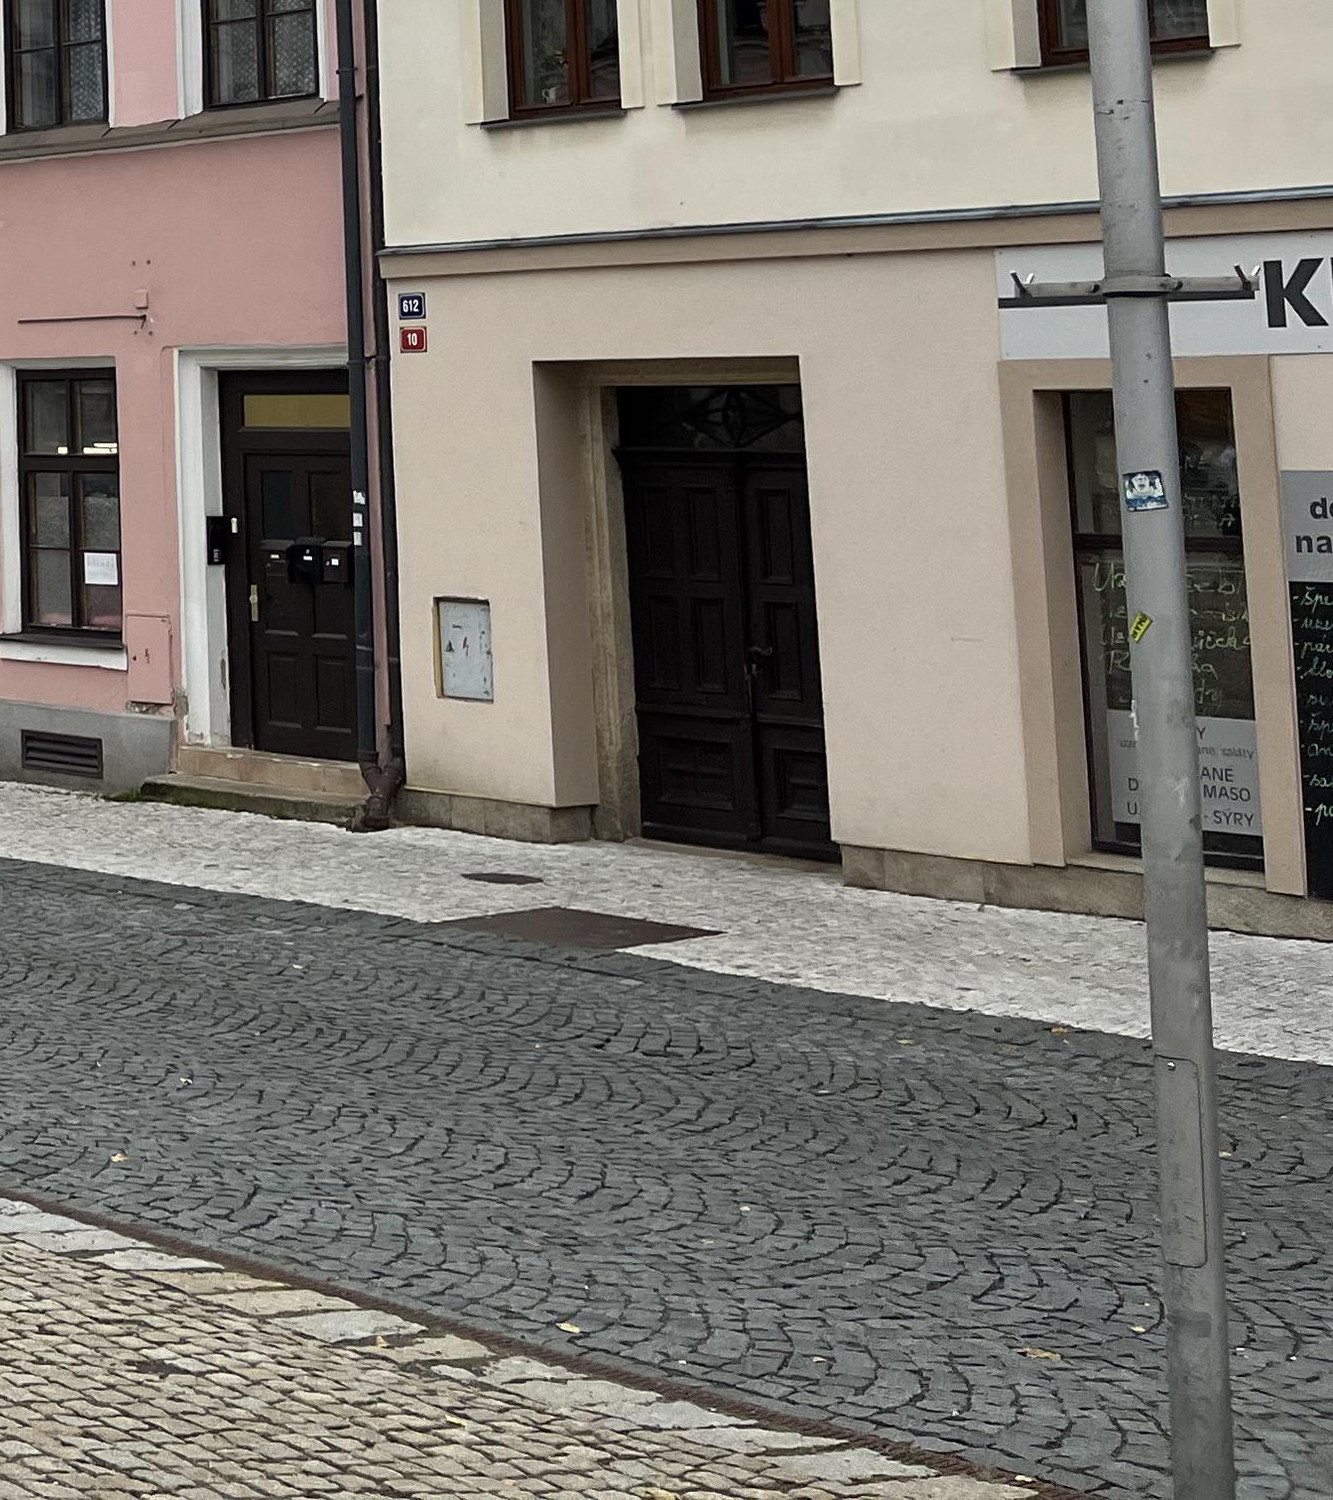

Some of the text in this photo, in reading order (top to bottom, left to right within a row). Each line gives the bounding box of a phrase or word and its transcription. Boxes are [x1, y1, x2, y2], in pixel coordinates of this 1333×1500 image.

[1264, 257, 1333, 328] K
[402, 299, 420, 313] 612
[407, 332, 418, 347] 10
[1309, 497, 1333, 520] d
[1203, 784, 1251, 803] MASO
[1213, 807, 1254, 827] SÝRY
